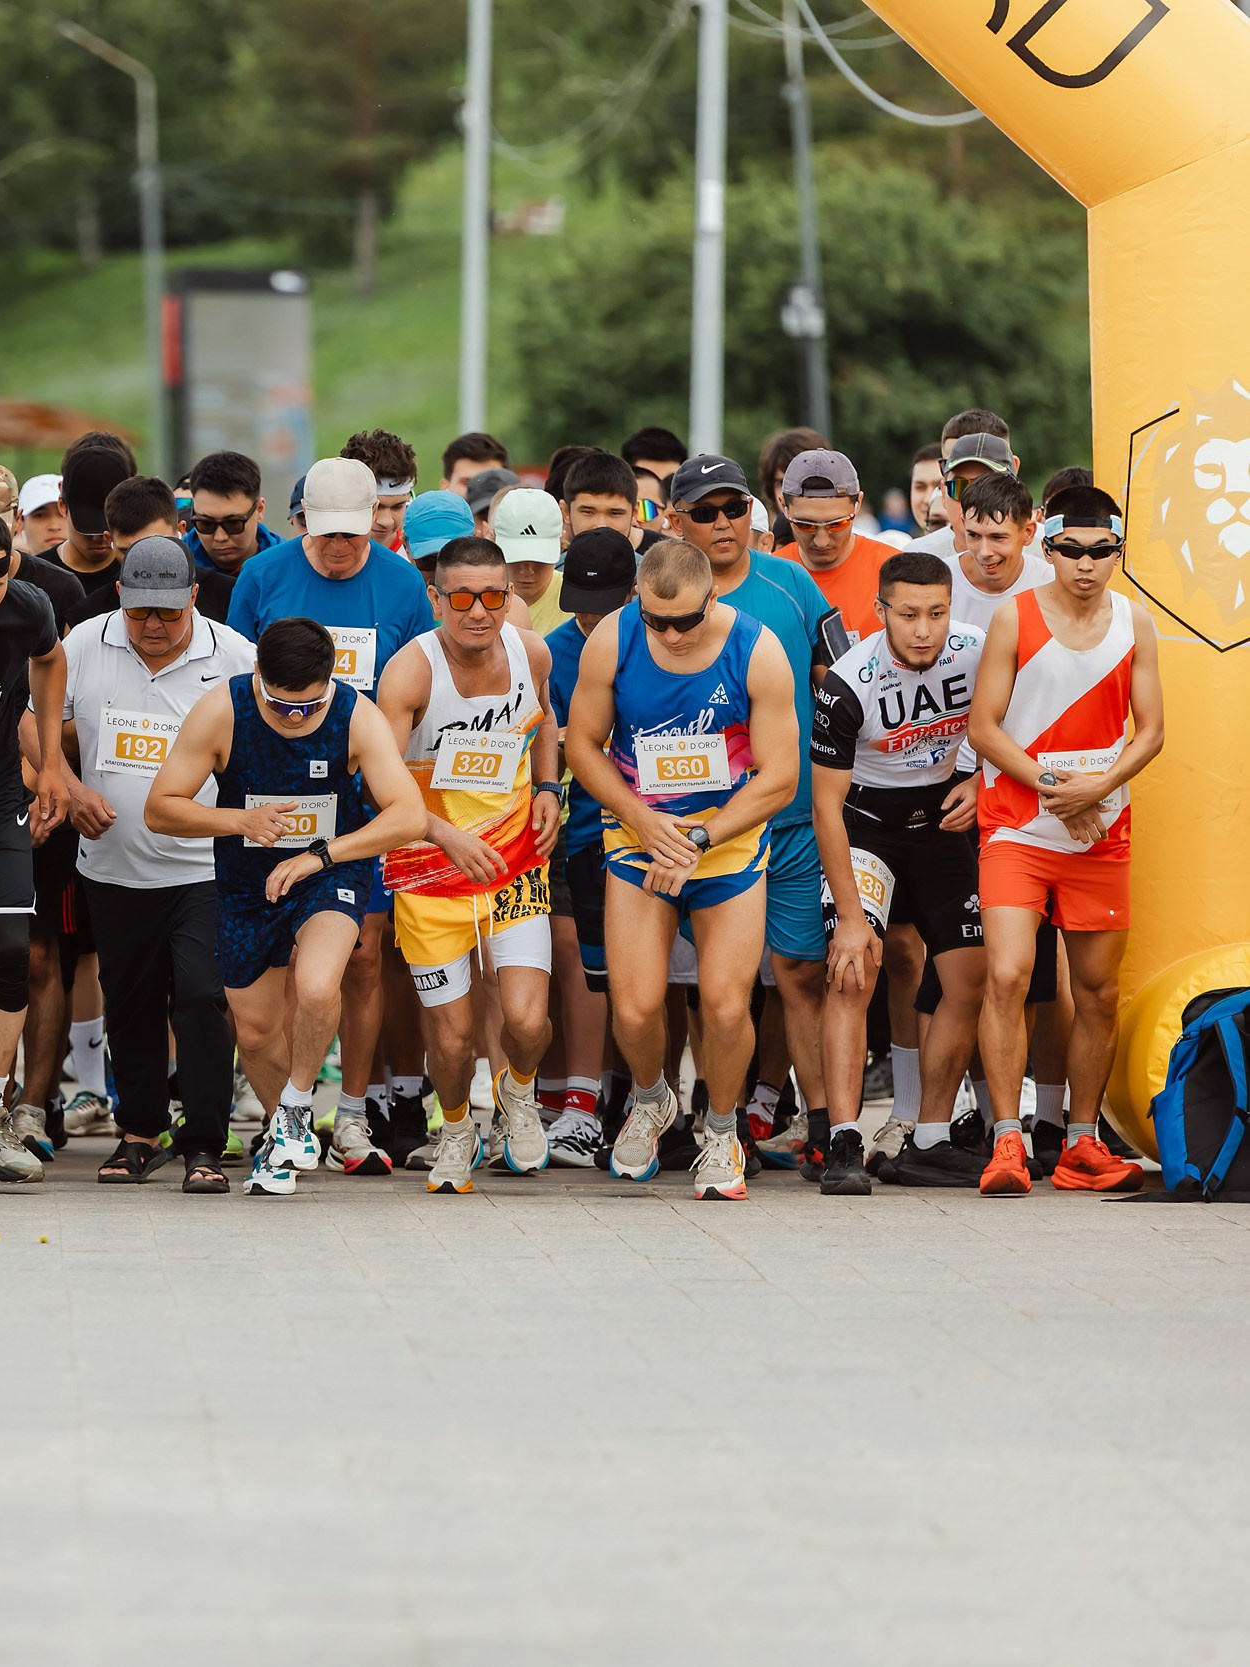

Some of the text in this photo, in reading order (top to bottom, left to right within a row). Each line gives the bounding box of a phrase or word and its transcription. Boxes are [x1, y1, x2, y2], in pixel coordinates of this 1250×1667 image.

[341, 635, 368, 644] D'ORO
[948, 634, 977, 652] G42
[858, 656, 880, 684] G42
[878, 673, 972, 730] UAE
[107, 717, 180, 733] LEONE D'ORO
[448, 737, 516, 749] LEONE D'ORO
[888, 719, 969, 752] Emirates
[122, 736, 162, 760] 192
[643, 741, 718, 752] LEONE D'ORO
[457, 755, 496, 774] 320
[661, 758, 704, 777] 360
[1045, 756, 1115, 768] LEONE D'ORO
[301, 801, 329, 809] D'ORO
